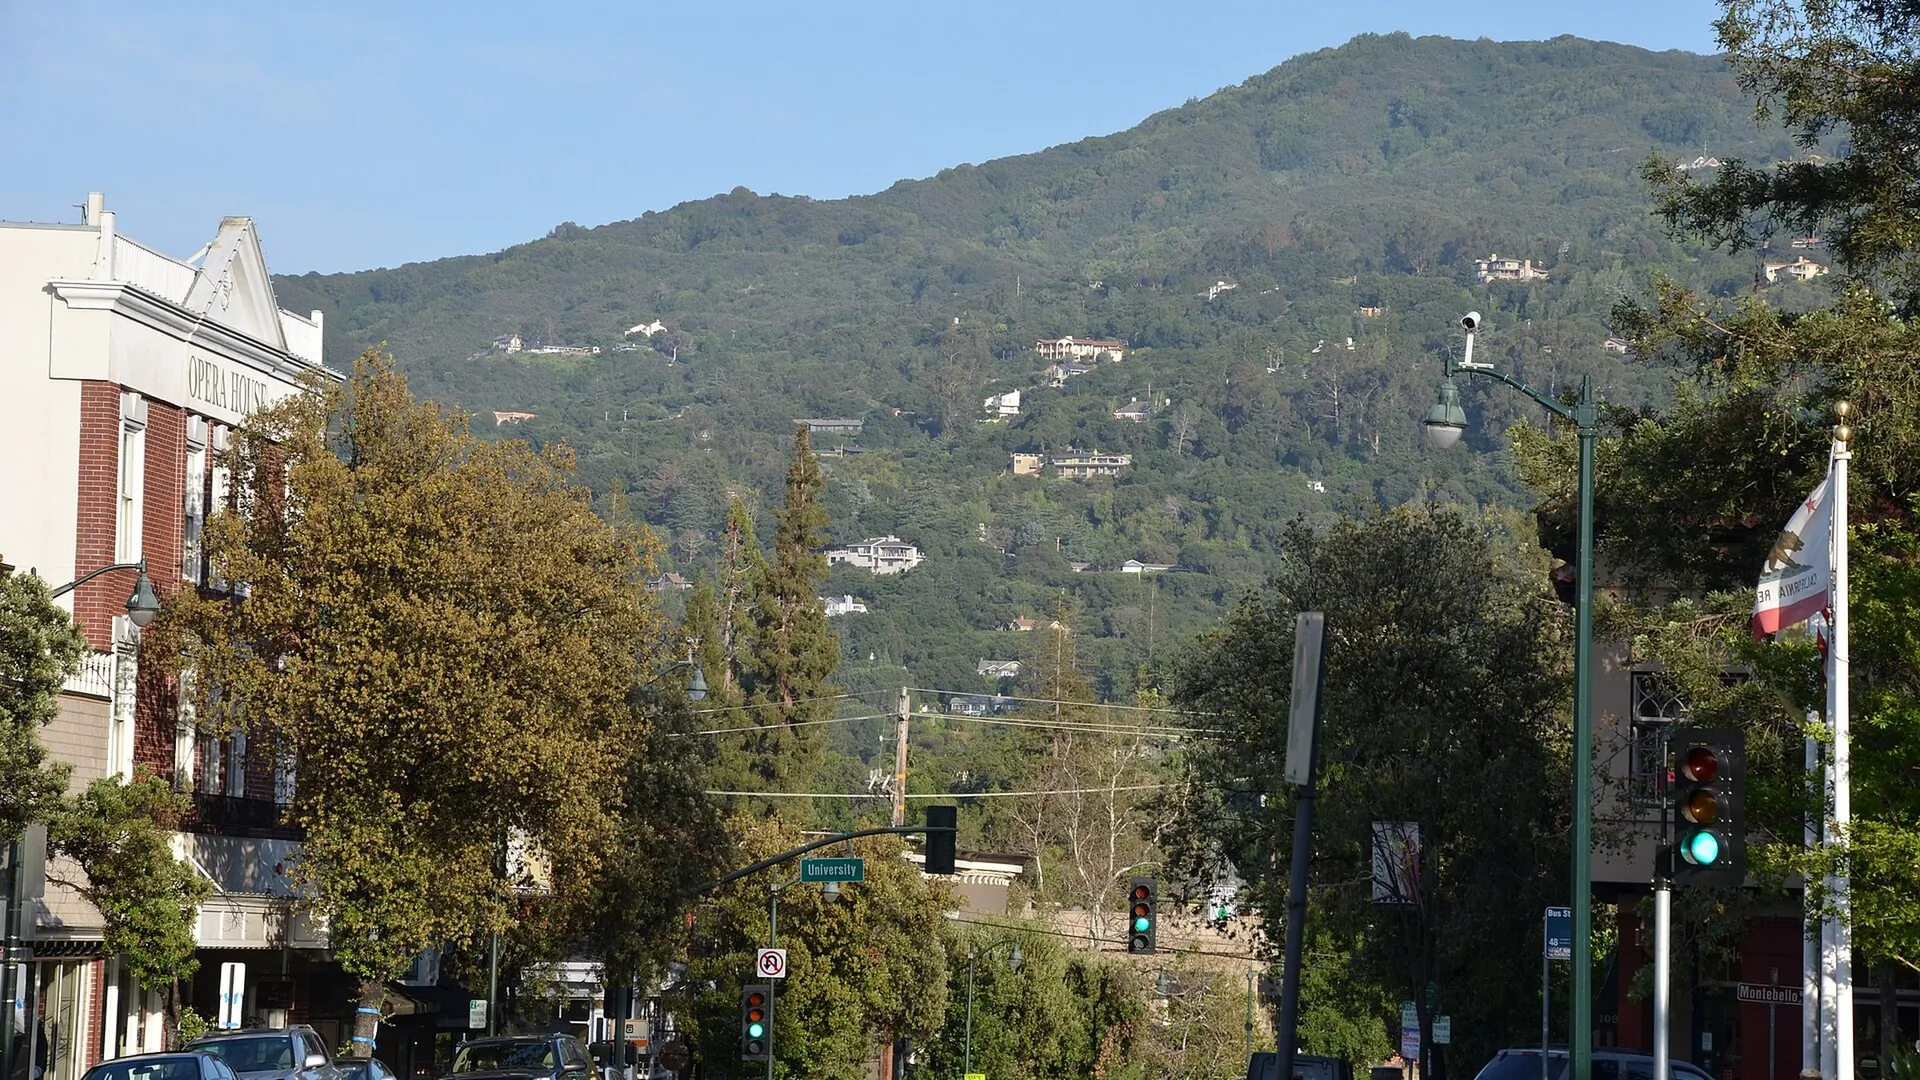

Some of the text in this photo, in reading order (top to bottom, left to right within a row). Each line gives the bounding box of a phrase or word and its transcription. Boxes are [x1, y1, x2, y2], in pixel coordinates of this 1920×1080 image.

[189, 355, 267, 415] OPERA HOUSE
[808, 864, 856, 877] University
[1547, 909, 1562, 917] Bus
[1548, 937, 1559, 947] 48
[1739, 985, 1798, 1003] Montebello
[1599, 1014, 1618, 1024] 109
